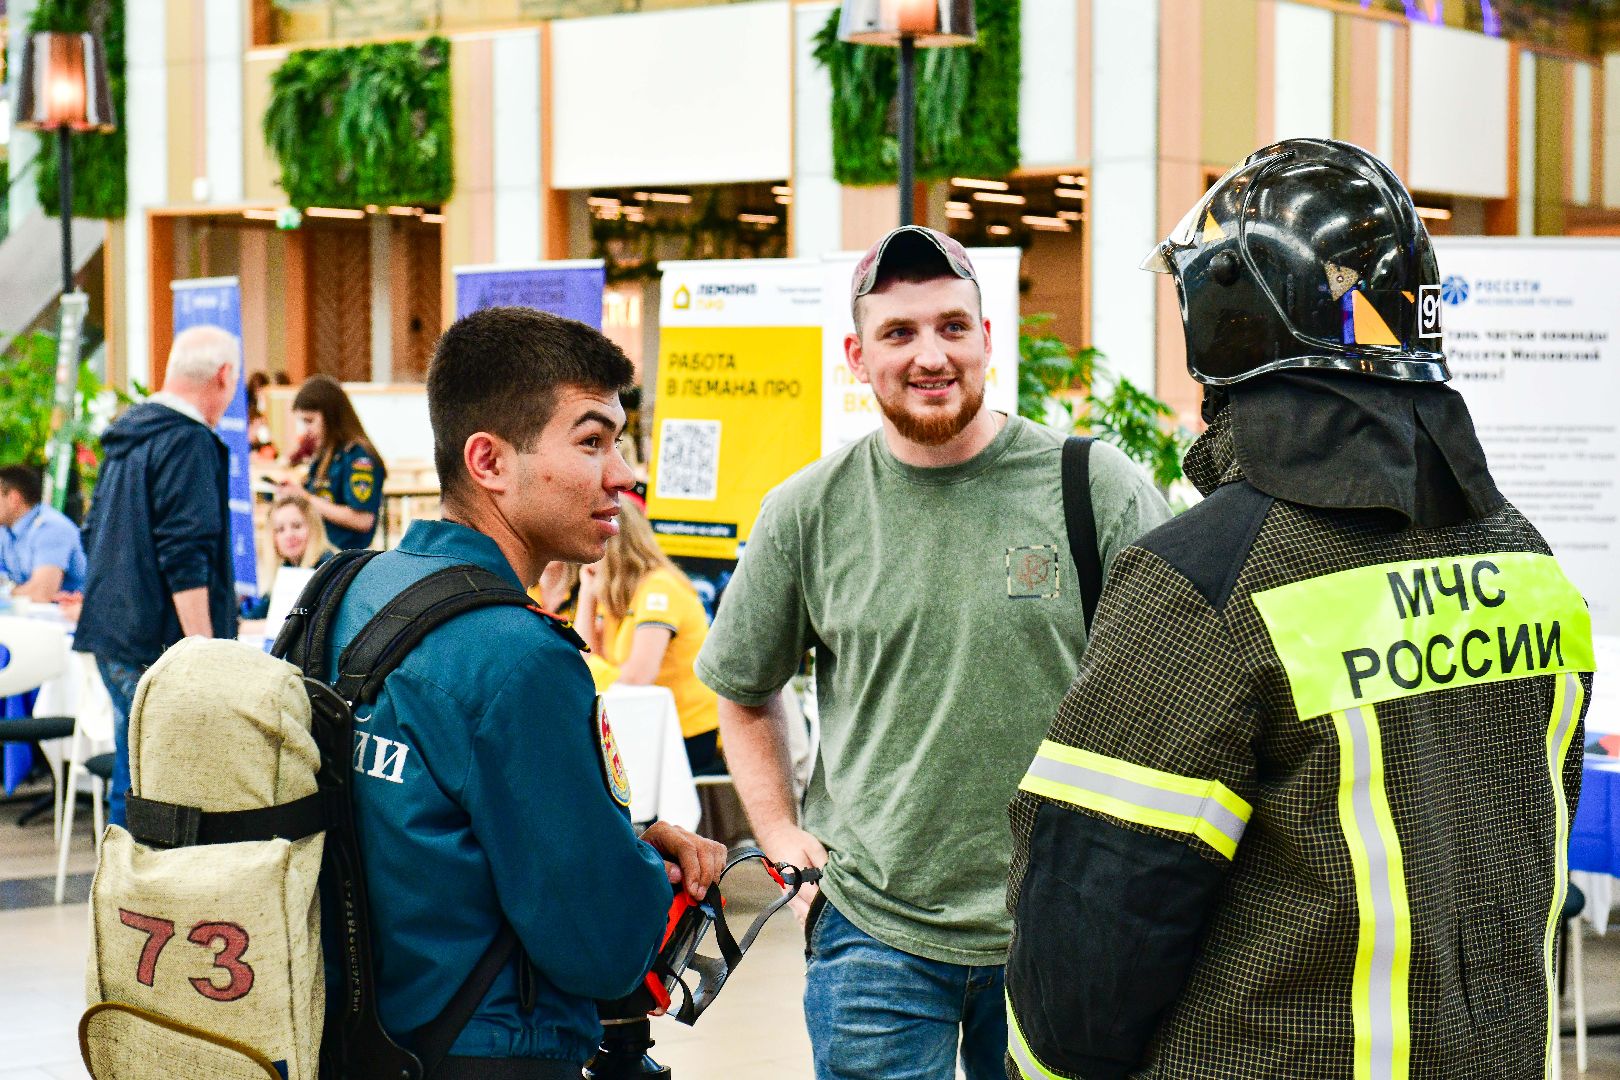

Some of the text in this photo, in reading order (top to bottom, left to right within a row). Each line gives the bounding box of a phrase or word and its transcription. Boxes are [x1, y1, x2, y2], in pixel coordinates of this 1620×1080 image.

[1475, 281, 1540, 292] РОССЕТИ
[669, 353, 737, 370] РАБОТА
[666, 378, 801, 399] В ЛЕМАНА ПРО
[1387, 560, 1505, 620] МЧС
[1342, 620, 1564, 699] РОССИИ
[118, 907, 255, 1002] 73
